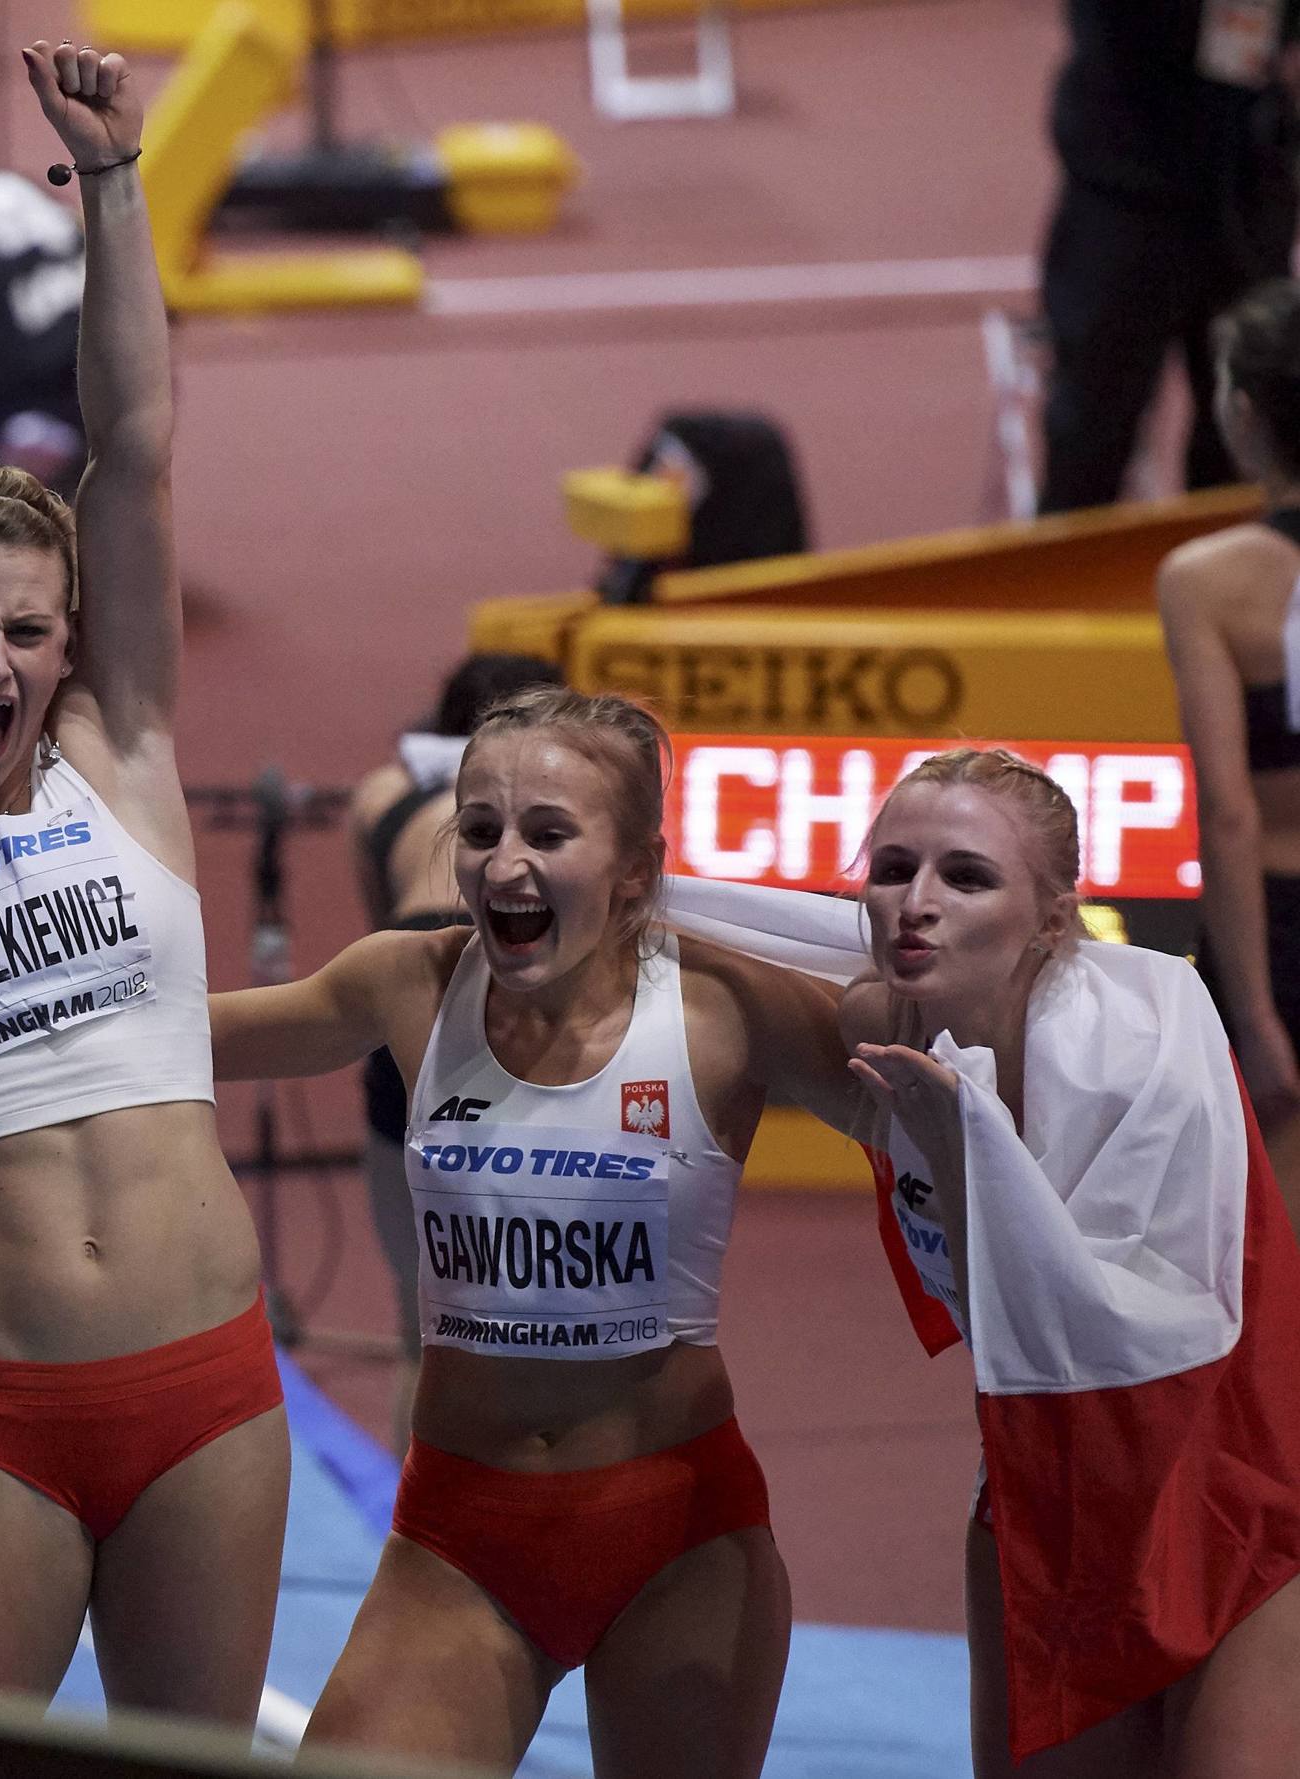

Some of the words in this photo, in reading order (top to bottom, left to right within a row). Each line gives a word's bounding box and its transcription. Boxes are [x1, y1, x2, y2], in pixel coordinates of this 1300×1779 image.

[591, 644, 965, 727] SEIKO
[97, 971, 148, 1009] 2018
[624, 1084, 665, 1094] POLSKA
[422, 1144, 524, 1175] TOYO
[530, 1149, 655, 1181] TIRES
[423, 1210, 655, 1290] GAWORSKA
[436, 1313, 599, 1347] BIRMINGHAM
[603, 1317, 658, 1344] 2018
